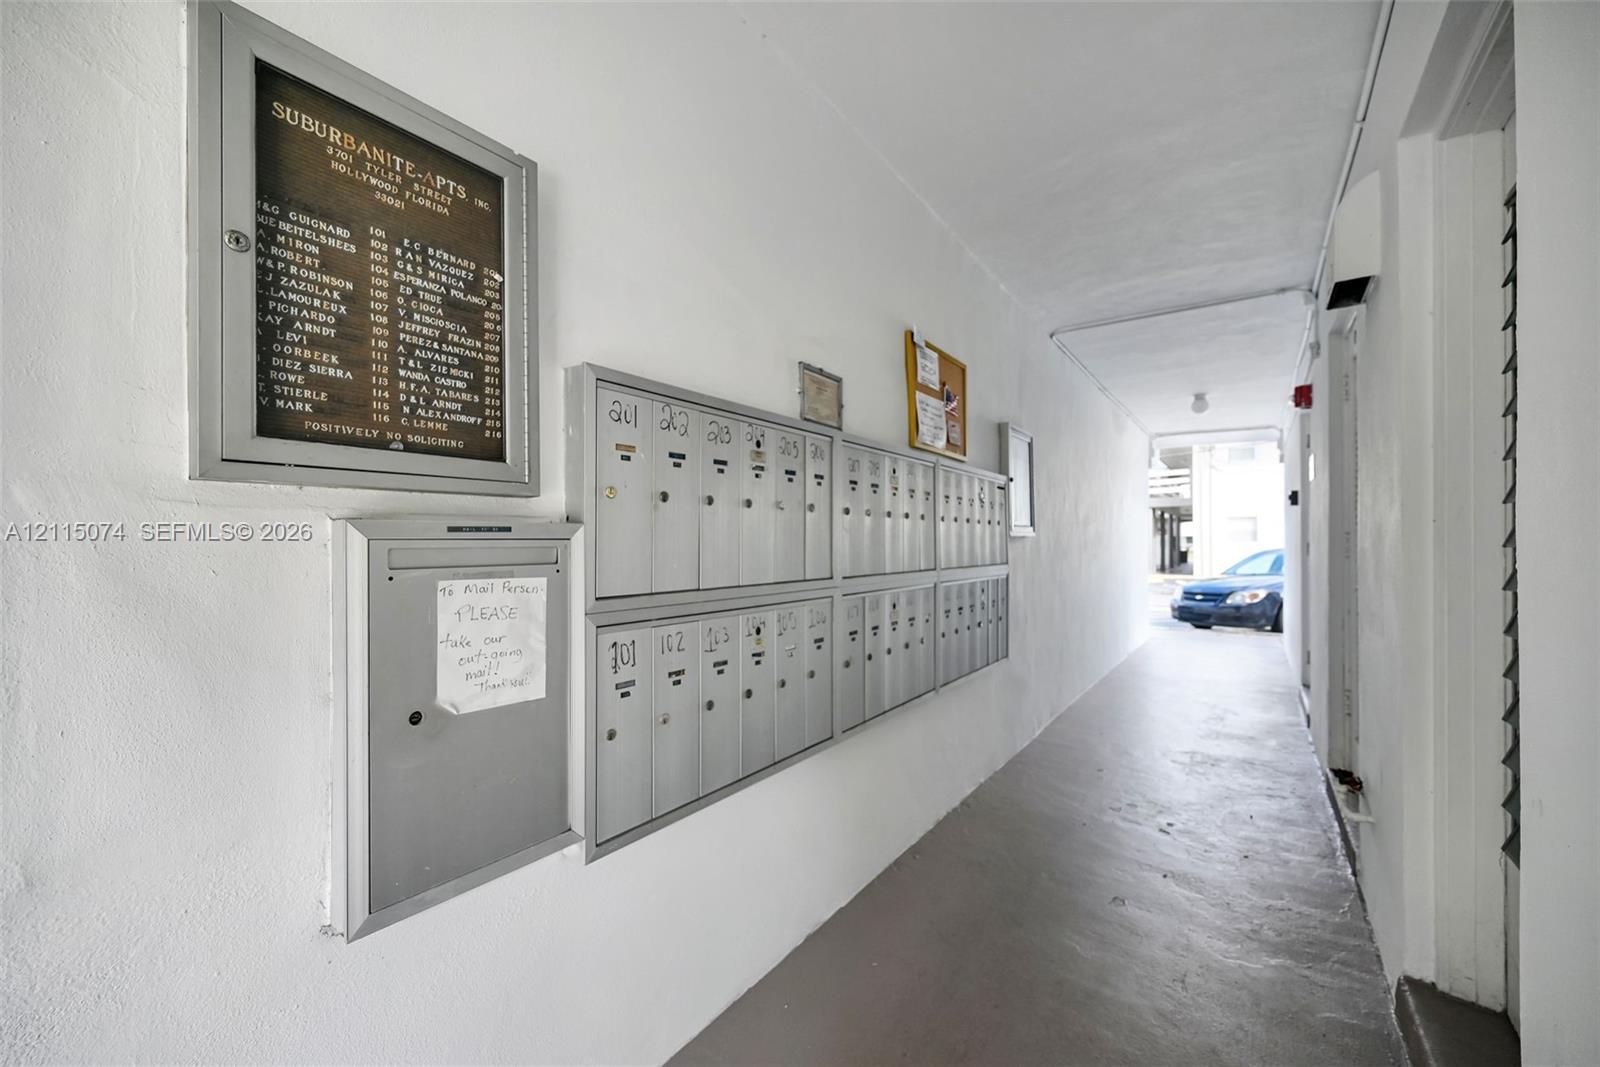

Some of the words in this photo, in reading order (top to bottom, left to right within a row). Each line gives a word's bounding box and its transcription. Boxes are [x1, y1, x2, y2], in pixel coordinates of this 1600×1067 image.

[272, 101, 468, 202] SUBURBANITE-APTS.
[474, 198, 492, 213] INC.
[326, 145, 353, 163] 3701
[365, 162, 402, 185] TYLER
[414, 183, 452, 205] STREET
[331, 160, 398, 194] HOLLYWOOD
[405, 191, 450, 216] FLORIDA
[374, 190, 405, 210] 33021
[278, 220, 357, 254] BEITELSHEES
[370, 239, 388, 252] 102
[289, 211, 350, 239] GUIGNARD
[370, 226, 386, 239] 101
[270, 245, 320, 268] ROBERT
[371, 263, 389, 276] 104
[276, 234, 320, 255] MIRON
[370, 251, 388, 263] 103
[427, 247, 476, 270] BERNARD
[265, 273, 273, 281] J
[280, 276, 341, 300] ZAZULAK
[370, 288, 388, 299] 106
[289, 264, 354, 291] ROBINSON
[371, 276, 389, 288] 105
[428, 258, 475, 281] VAZQUEZ
[483, 278, 500, 289] 202
[428, 270, 465, 289] MIRICA
[484, 289, 500, 299] 203
[270, 287, 348, 315] LAMOUREUX
[370, 300, 389, 312] 107
[393, 271, 447, 294] ESPERANZA
[450, 288, 488, 306] POLANCO
[491, 302, 503, 311] 20
[399, 285, 413, 295] ED
[418, 291, 443, 304] TRUE
[484, 310, 500, 321] 205
[269, 300, 335, 324] PICHARDO
[370, 313, 388, 324] 108
[398, 308, 408, 318] V.
[413, 312, 468, 334] MISCIOSCIA
[483, 332, 500, 342] 207
[411, 300, 444, 316] CIOCA
[483, 321, 502, 332] 206
[276, 330, 307, 345] LEVI
[371, 338, 388, 349] 110
[293, 320, 337, 338] ARNDT
[372, 326, 389, 337] 109
[398, 320, 440, 338] JEFFREY
[447, 333, 482, 348] FRAZIN
[484, 342, 500, 353] 208
[272, 343, 340, 365] OORBEEK
[371, 351, 388, 361] 111
[397, 345, 407, 354] A.
[414, 349, 460, 366] ALVARES
[484, 364, 500, 373] 210
[484, 354, 499, 363] 209
[270, 370, 305, 385] ROWE
[372, 376, 389, 386] 113
[272, 357, 302, 371] DIEZ
[308, 363, 353, 380] SIERRA
[372, 363, 389, 374] 112
[398, 368, 430, 382] WANDA
[434, 376, 467, 389] CASTRO
[484, 386, 500, 395] 212
[484, 375, 499, 385] 211
[259, 396, 270, 407] V.
[275, 399, 313, 413] MARK
[373, 401, 390, 411] 115
[273, 384, 328, 401] STIERLE
[373, 388, 390, 399] 114
[435, 388, 480, 403] TABARES
[484, 397, 501, 406] 213
[373, 413, 390, 423] 116
[402, 405, 410, 414] N
[416, 407, 483, 425] ALEXANDROFF
[485, 419, 501, 428] 215
[432, 399, 463, 411] ARNDT
[485, 408, 501, 417] 214
[608, 400, 637, 429] 201
[304, 420, 380, 438] POSITIVELY
[386, 431, 402, 441] NO
[407, 433, 465, 449] SOLICITING
[401, 418, 410, 427] C.
[413, 419, 449, 432] LEMME
[484, 429, 502, 439] 216
[439, 584, 454, 597] To
[463, 582, 495, 595] Mail
[454, 604, 519, 623] PLEASE
[439, 633, 472, 649] take
[483, 634, 509, 645] our
[661, 631, 686, 655] 102
[704, 627, 730, 652] 103
[608, 639, 637, 675] 101
